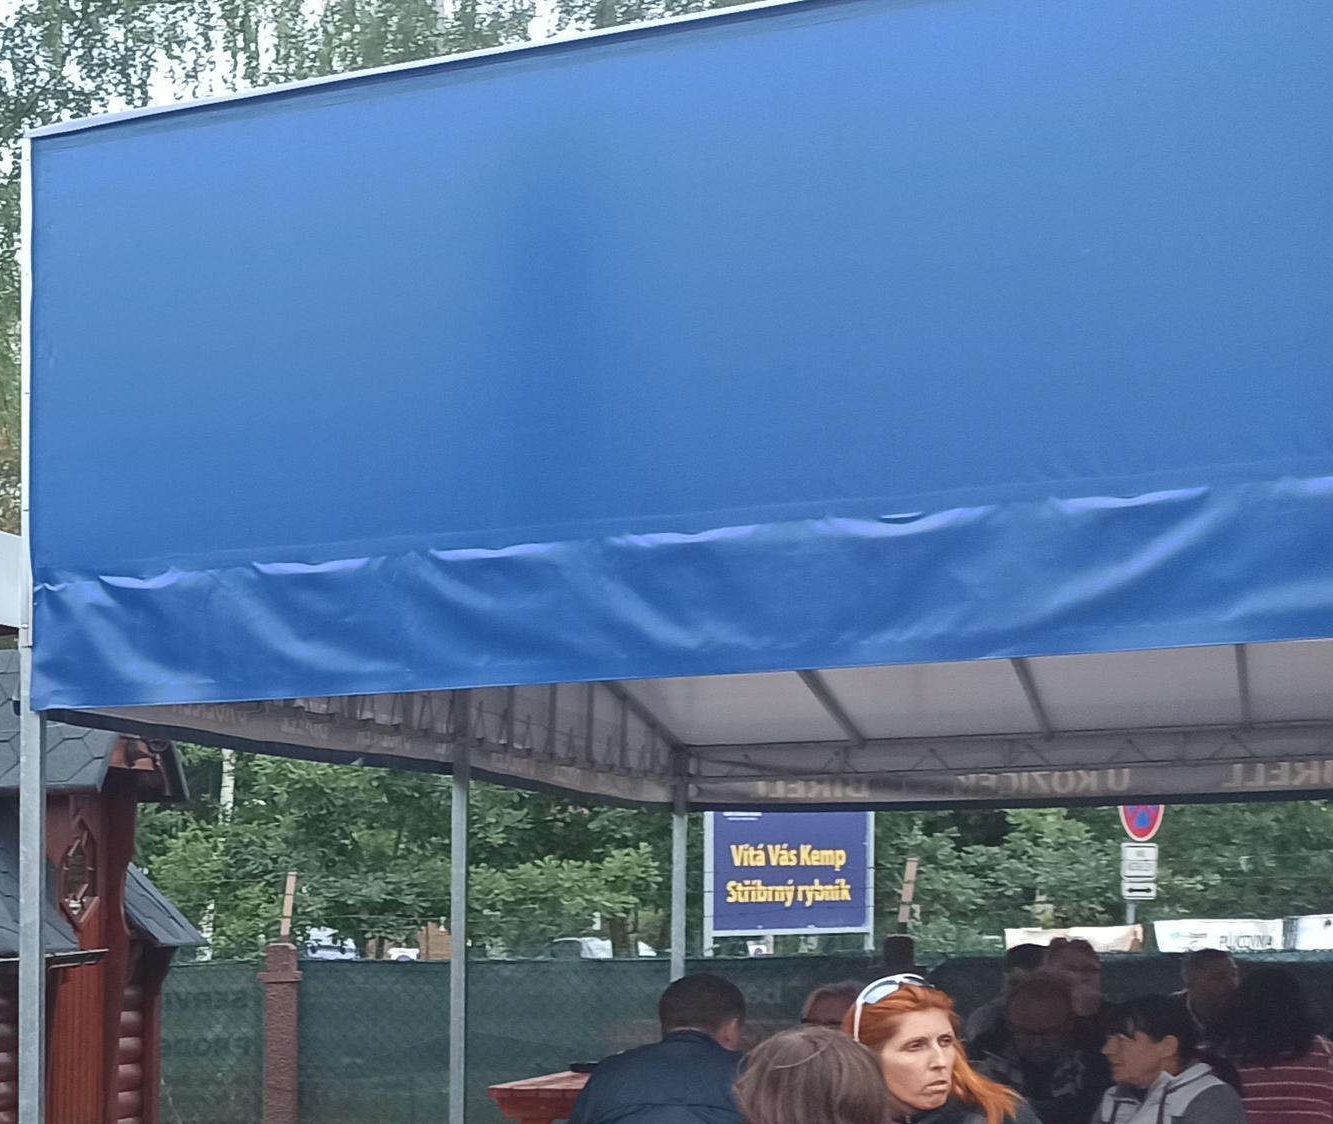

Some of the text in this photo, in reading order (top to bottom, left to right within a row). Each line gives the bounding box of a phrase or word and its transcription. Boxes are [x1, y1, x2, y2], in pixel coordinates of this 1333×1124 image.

[767, 843, 798, 866] Vás
[799, 844, 847, 871] Kemp
[726, 878, 852, 908] Stříbrný rybník
